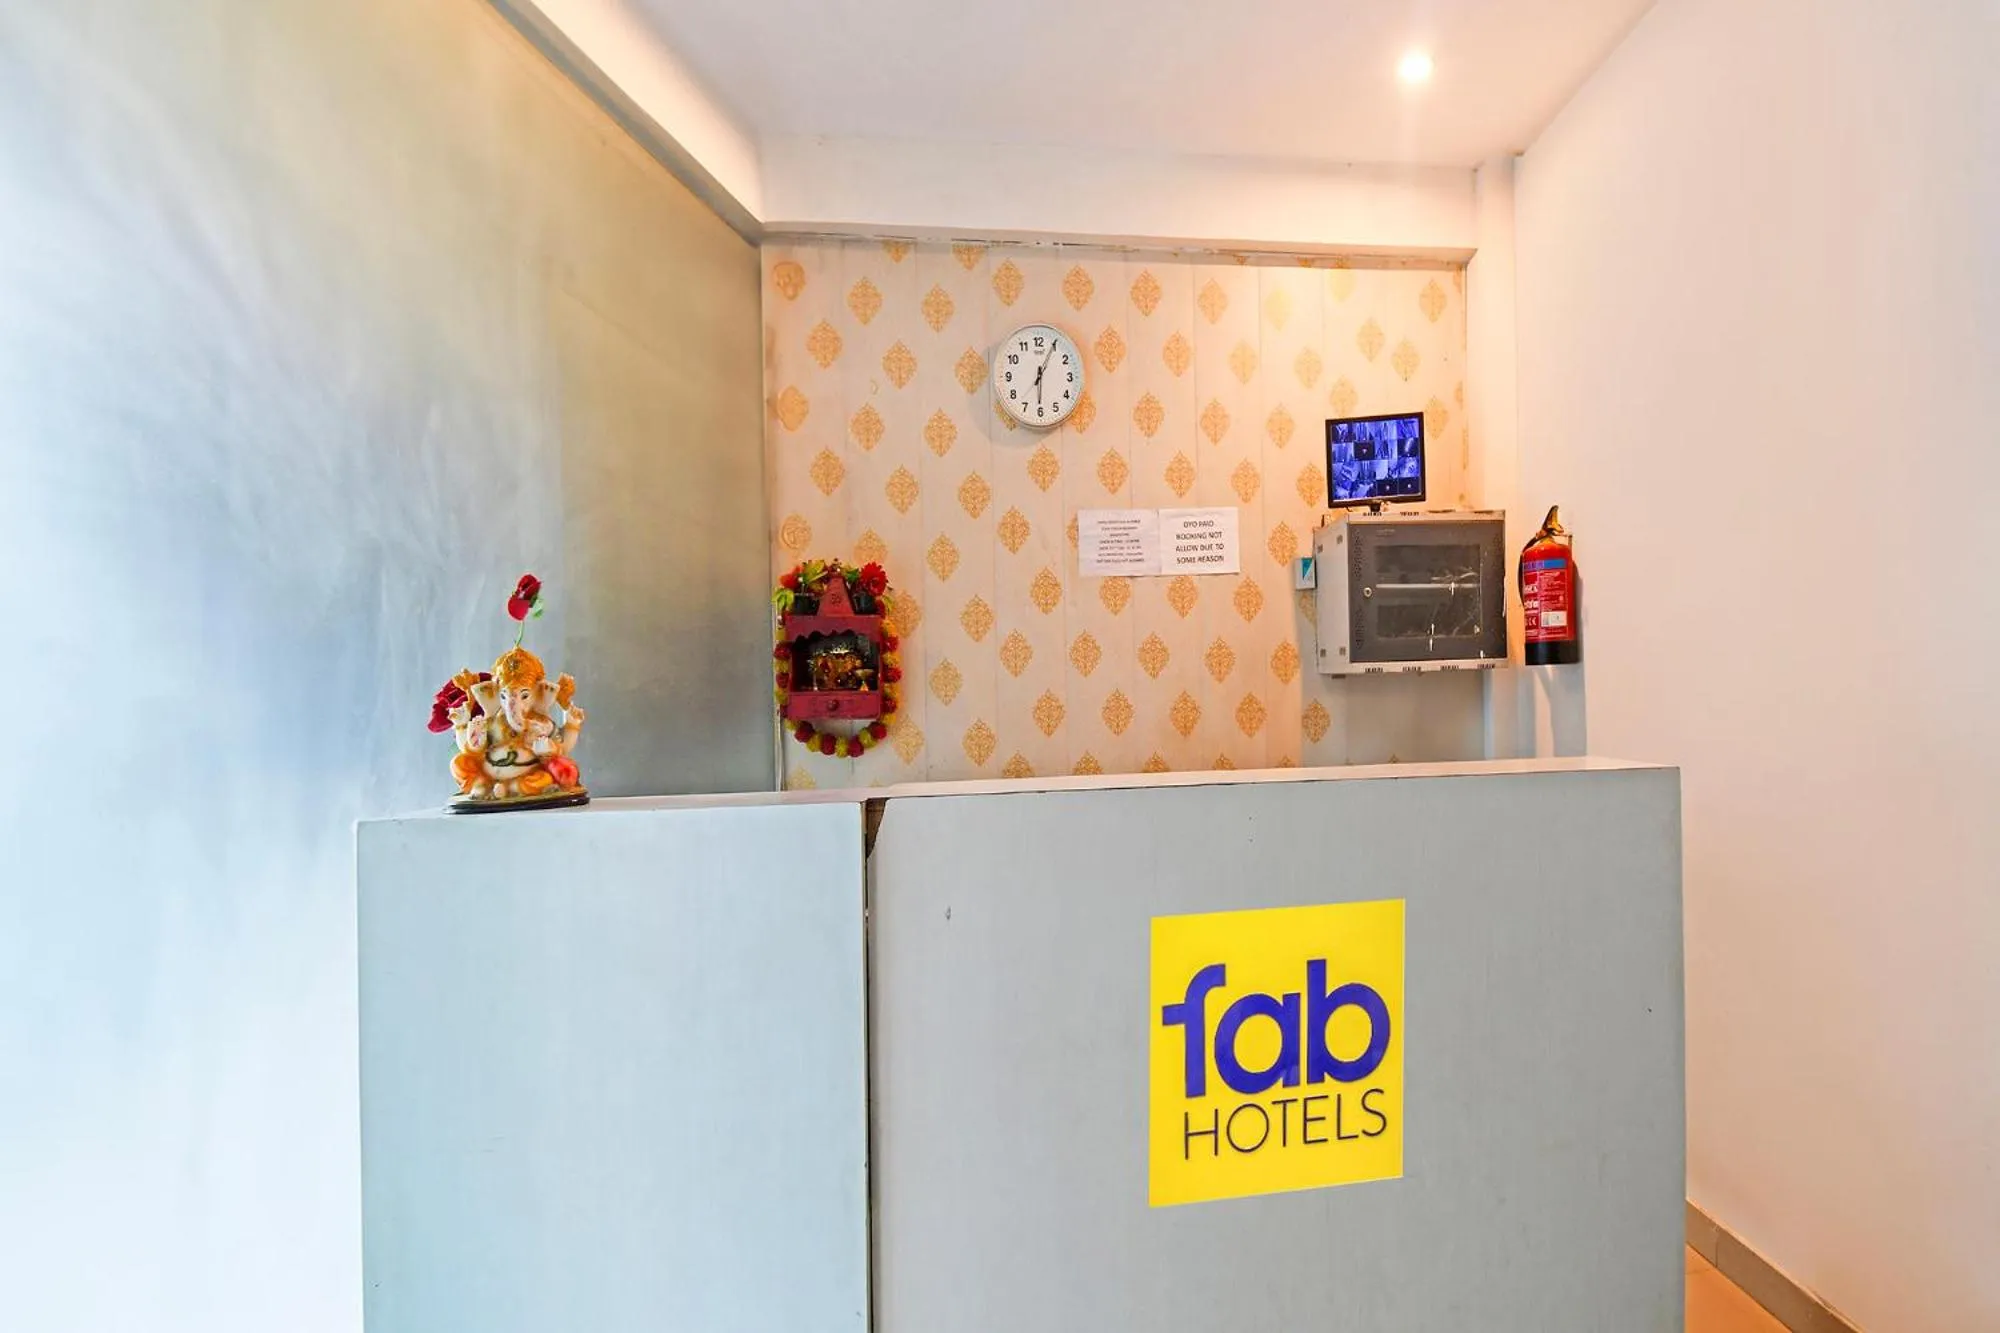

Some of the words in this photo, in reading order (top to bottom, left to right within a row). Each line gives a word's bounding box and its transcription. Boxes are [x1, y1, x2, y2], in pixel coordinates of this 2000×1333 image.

[1019, 341, 1028, 351] 11
[1033, 337, 1044, 347] 12
[1008, 354, 1019, 365] 10
[1062, 355, 1069, 365] 2
[1005, 372, 1012, 382] 9
[1067, 372, 1073, 382] 3
[1010, 389, 1017, 399] 8
[1063, 390, 1070, 399] 4
[1022, 402, 1029, 412] 7
[1037, 407, 1044, 417] 6
[1053, 402, 1059, 412] 5
[1175, 532, 1207, 540] BOOKING
[1208, 531, 1222, 539] NOT
[1176, 556, 1196, 564] SOME
[1197, 555, 1224, 563] REASON
[1161, 958, 1391, 1099] fab
[1184, 1088, 1388, 1160] HOTELS
